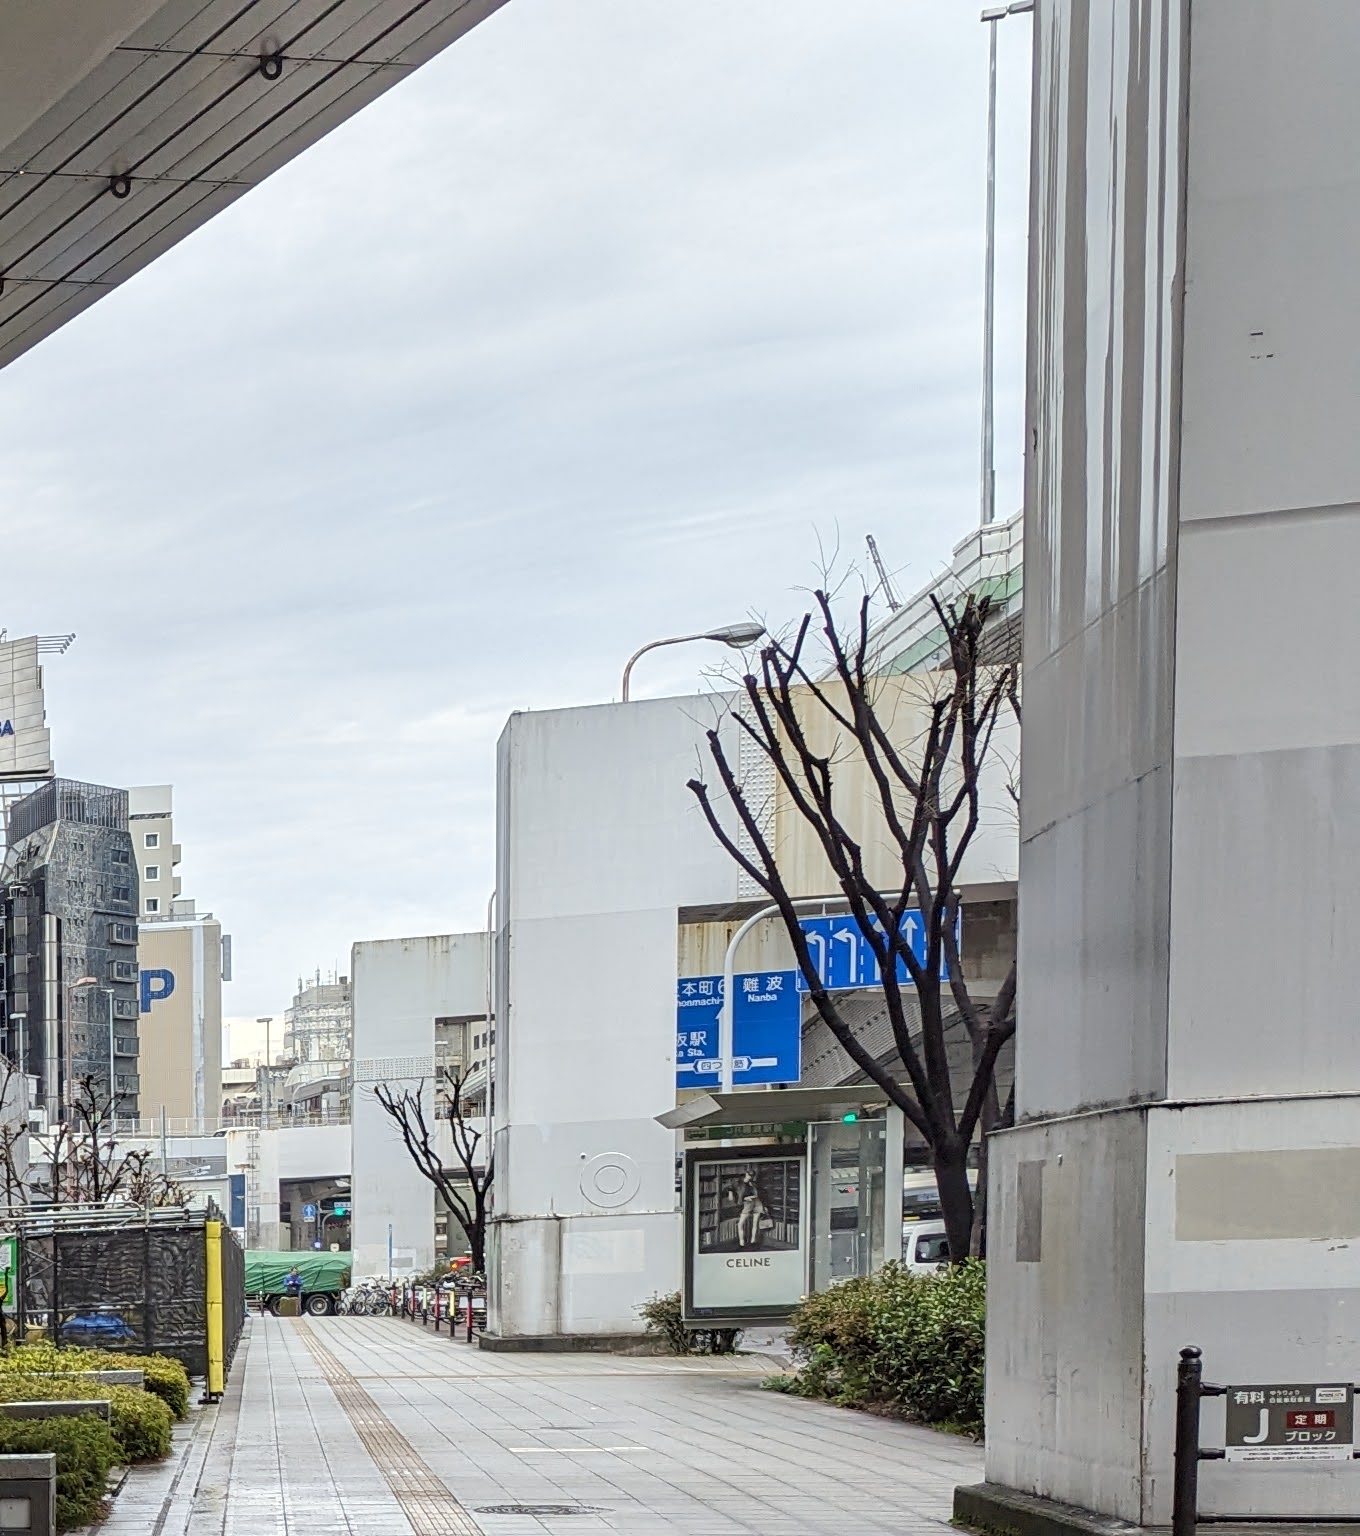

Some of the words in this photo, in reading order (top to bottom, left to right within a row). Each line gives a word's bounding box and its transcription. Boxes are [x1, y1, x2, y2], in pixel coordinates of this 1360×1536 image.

[140, 968, 175, 1013] P
[677, 979, 725, 997] 本町6
[742, 975, 784, 992] 難波
[747, 993, 778, 1002] Nanba
[726, 1257, 771, 1268] CELINE
[1234, 1391, 1265, 1405] 有料
[1243, 1408, 1269, 1444] J
[1294, 1414, 1327, 1425] 定期
[1285, 1430, 1336, 1442] ブロック
